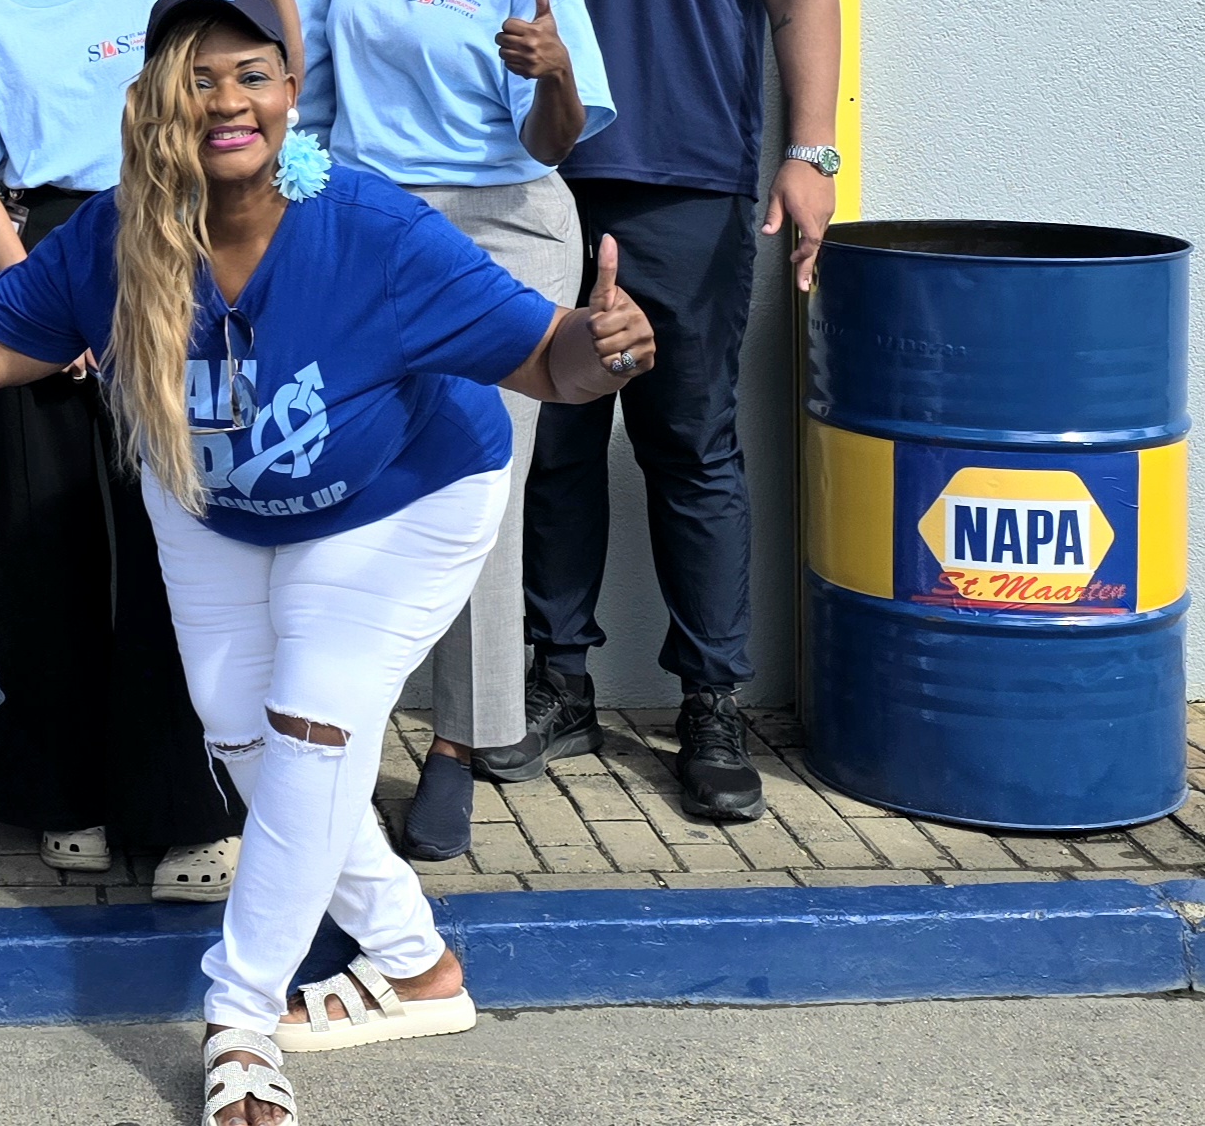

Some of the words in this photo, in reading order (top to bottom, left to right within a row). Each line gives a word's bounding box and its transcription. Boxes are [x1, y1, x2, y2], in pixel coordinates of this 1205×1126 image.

[87, 35, 131, 63] SLS
[185, 359, 257, 421] AN
[311, 480, 348, 509] UP
[953, 504, 1085, 566] NAPA
[932, 571, 984, 597] St.
[988, 572, 1127, 602] Maarten
